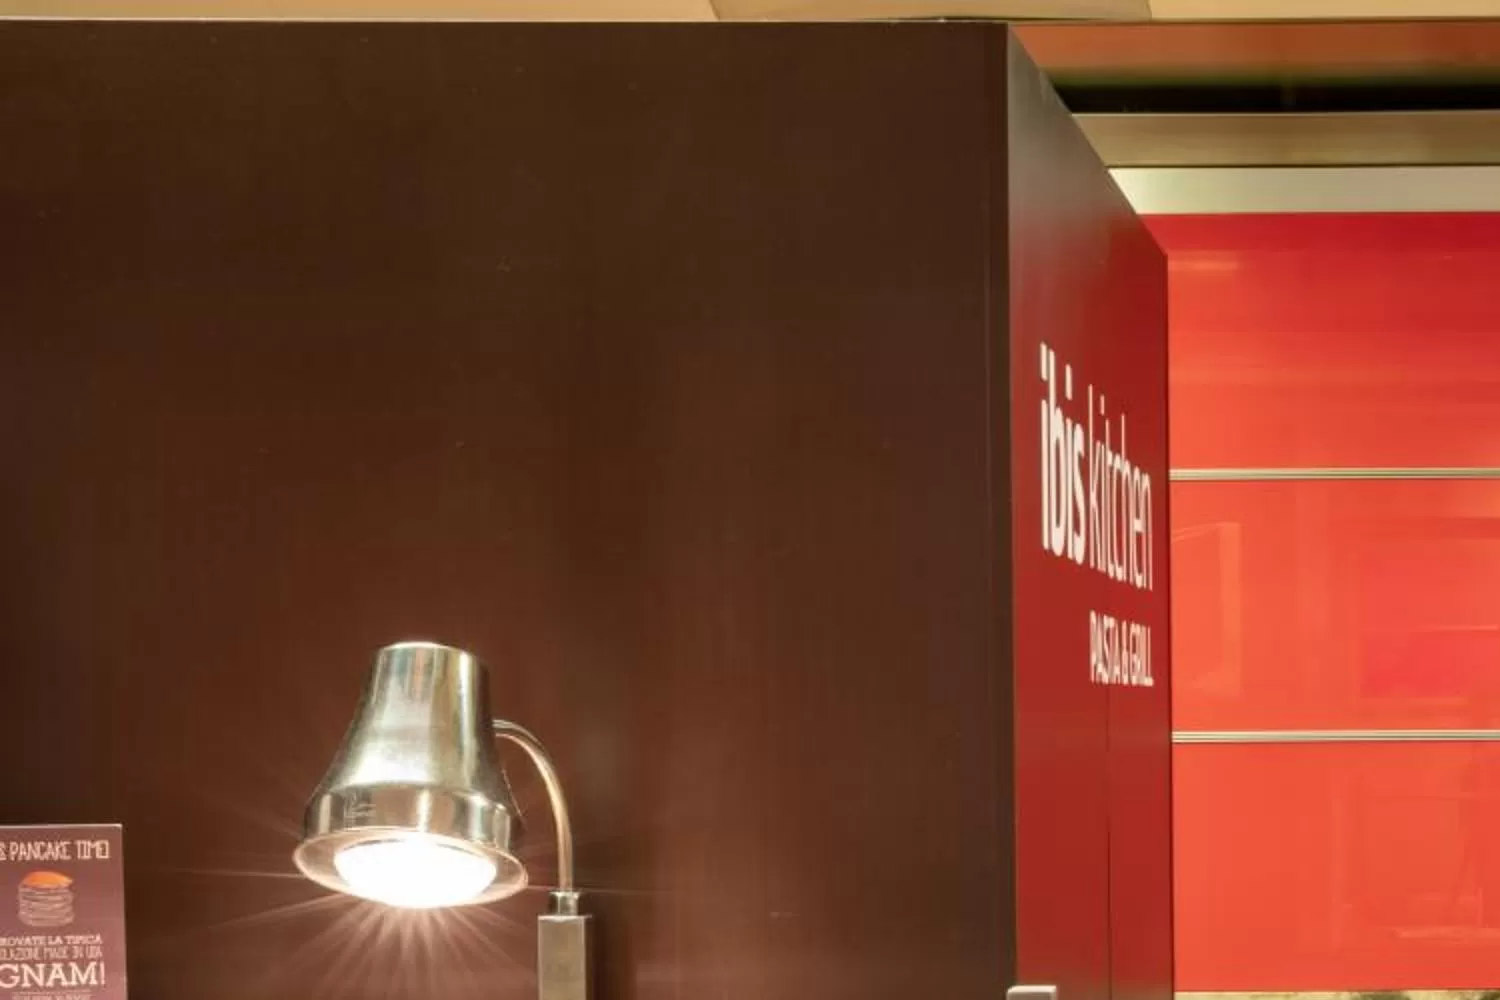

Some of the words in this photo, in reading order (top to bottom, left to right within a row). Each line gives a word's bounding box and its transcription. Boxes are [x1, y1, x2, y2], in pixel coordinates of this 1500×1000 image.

[1040, 341, 1086, 566] ibis
[1088, 383, 1154, 592] kitchen
[1089, 608, 1120, 685] PASTA
[9, 840, 72, 861] PANCAKE
[0, 961, 106, 989] GNAM!
